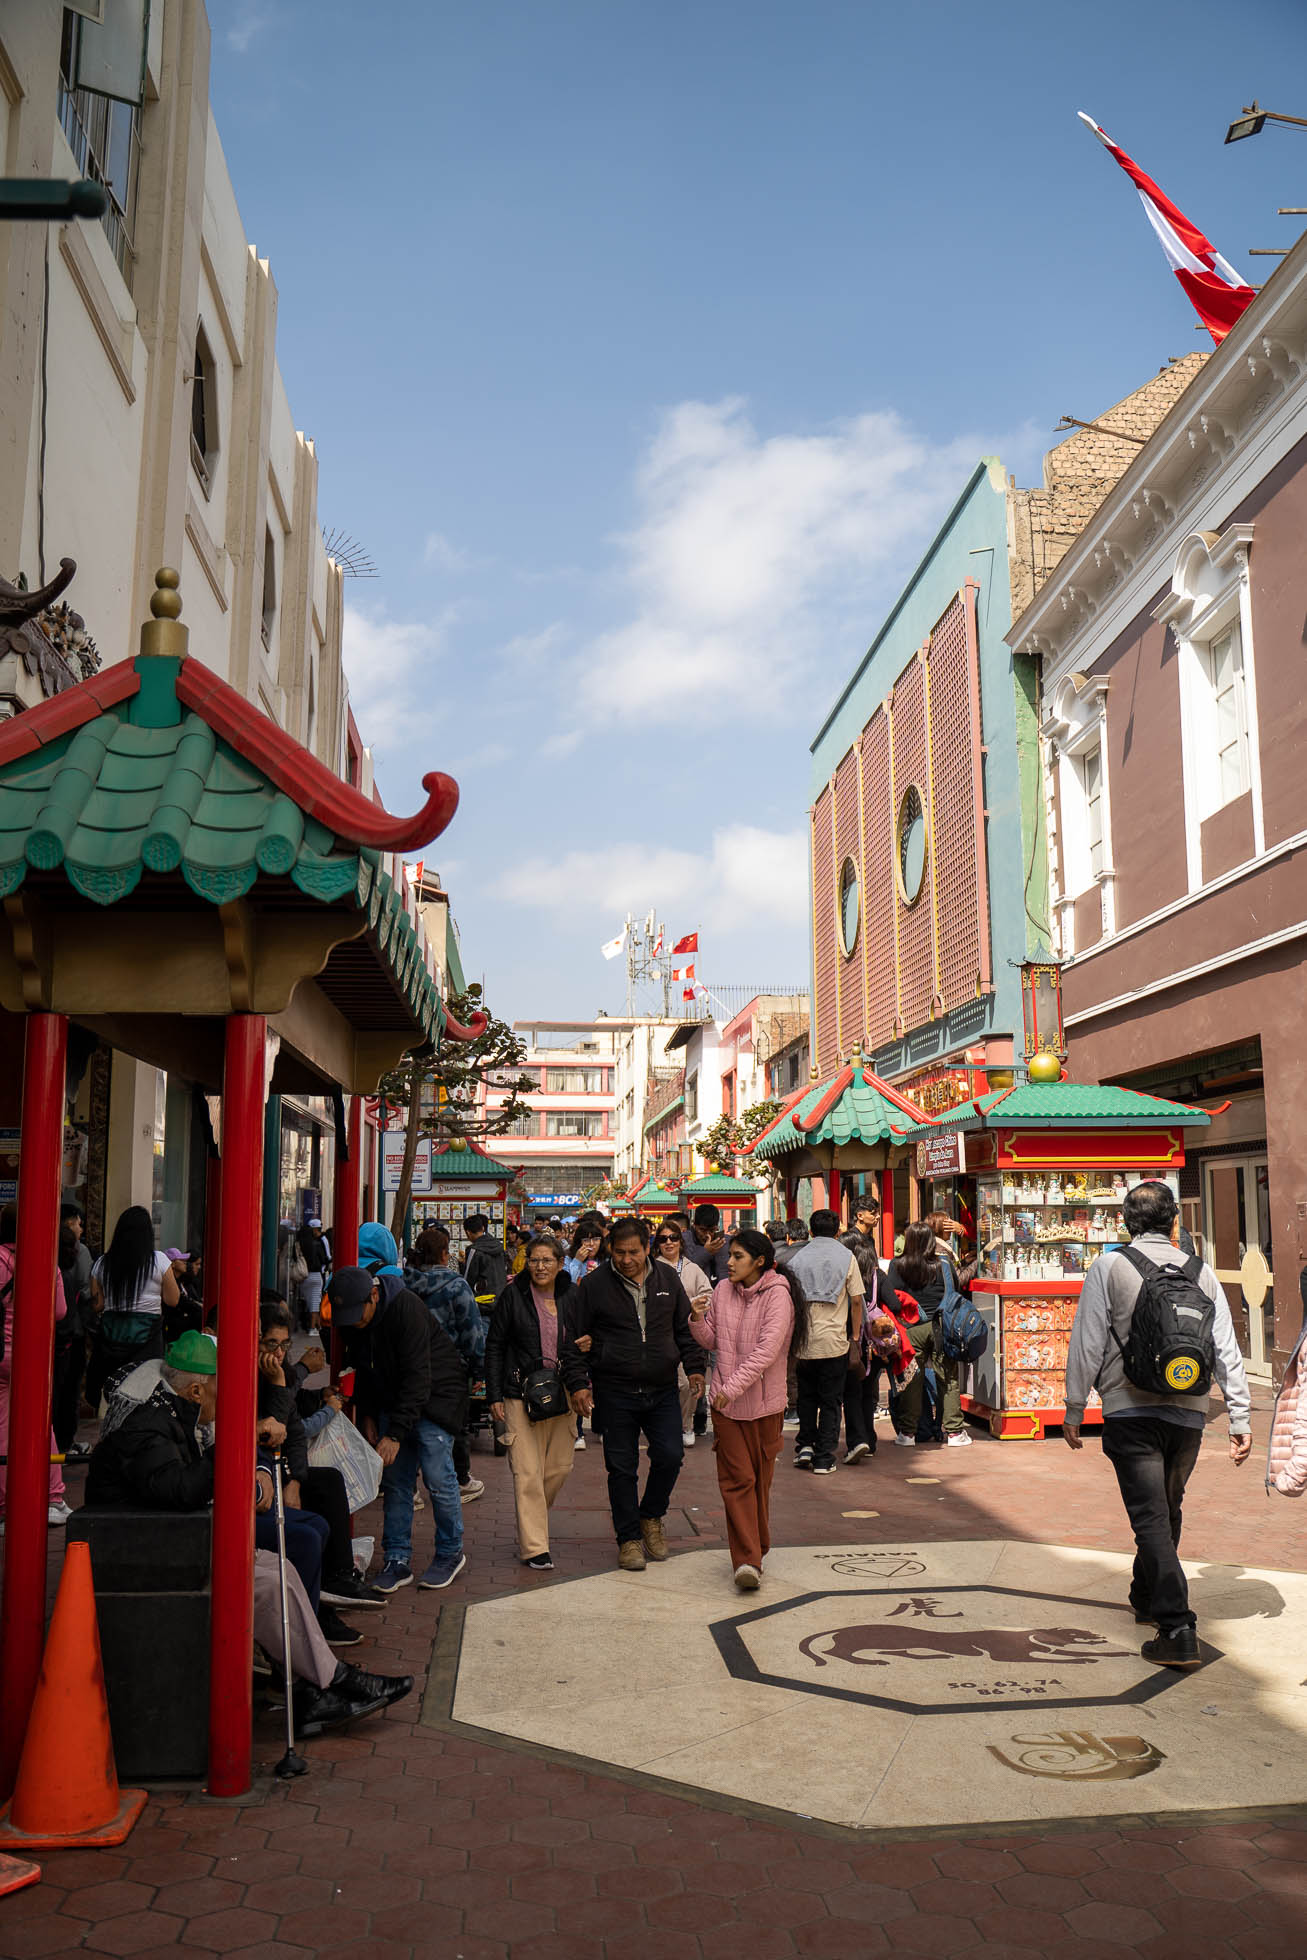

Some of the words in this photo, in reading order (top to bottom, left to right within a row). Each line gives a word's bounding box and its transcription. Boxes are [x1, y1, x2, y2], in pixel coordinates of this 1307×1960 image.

[558, 1195, 579, 1205] BCP
[884, 1597, 965, 1618] 虎
[994, 1680, 1021, 1688] 62
[976, 1688, 1005, 1696] 86
[1019, 1686, 1047, 1694] 98
